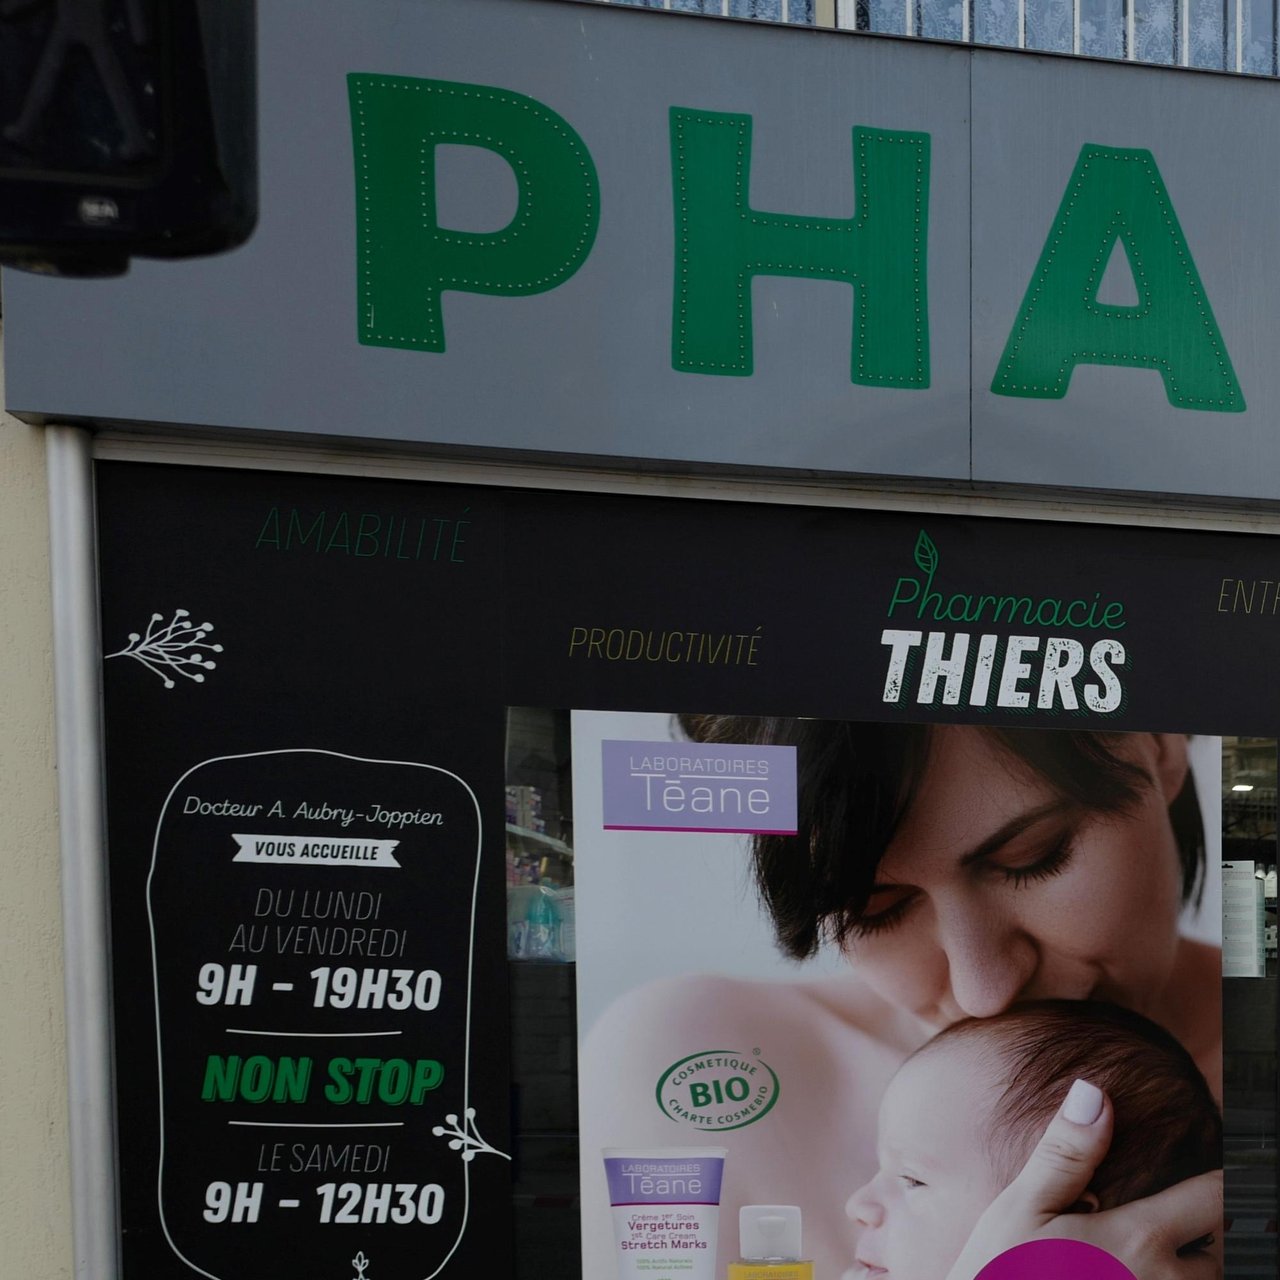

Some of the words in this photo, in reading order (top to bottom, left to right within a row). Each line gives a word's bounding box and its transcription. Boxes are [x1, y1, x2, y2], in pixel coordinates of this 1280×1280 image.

[255, 505, 472, 563] AMABILITÉ
[887, 572, 1127, 630] Pharmacie
[568, 625, 763, 666] PRODUCTIVITÉ
[880, 628, 1130, 714] THIERS
[630, 756, 769, 775] LABORATOIRES
[183, 796, 262, 818] Docteur
[267, 800, 286, 819] A.
[293, 801, 444, 829] Aubry-Joppien
[255, 840, 296, 858] VOUS
[300, 842, 379, 861] ACCUEILLE
[254, 887, 294, 919] DU
[301, 890, 382, 921] LUNDI
[228, 923, 268, 954] AU
[276, 926, 407, 958] VENDREDI
[195, 962, 258, 1007] 9H
[310, 966, 443, 1012] 19H30
[201, 1054, 313, 1104] NON
[323, 1056, 446, 1106] STOP
[672, 1058, 758, 1086] COSMETIQUE
[669, 1099, 712, 1125] CHARTE
[717, 1086, 768, 1125] COSMEBIO
[689, 1076, 750, 1108] BIO
[257, 1143, 285, 1173] LE
[288, 1143, 391, 1174] SAMEDI
[622, 1164, 700, 1174] LABORATOIRES
[202, 1181, 264, 1224] 9H
[315, 1182, 446, 1225] 12H30
[627, 1221, 700, 1233] Vergetures
[621, 1240, 668, 1250] Stretch
[671, 1240, 707, 1249] Marks
